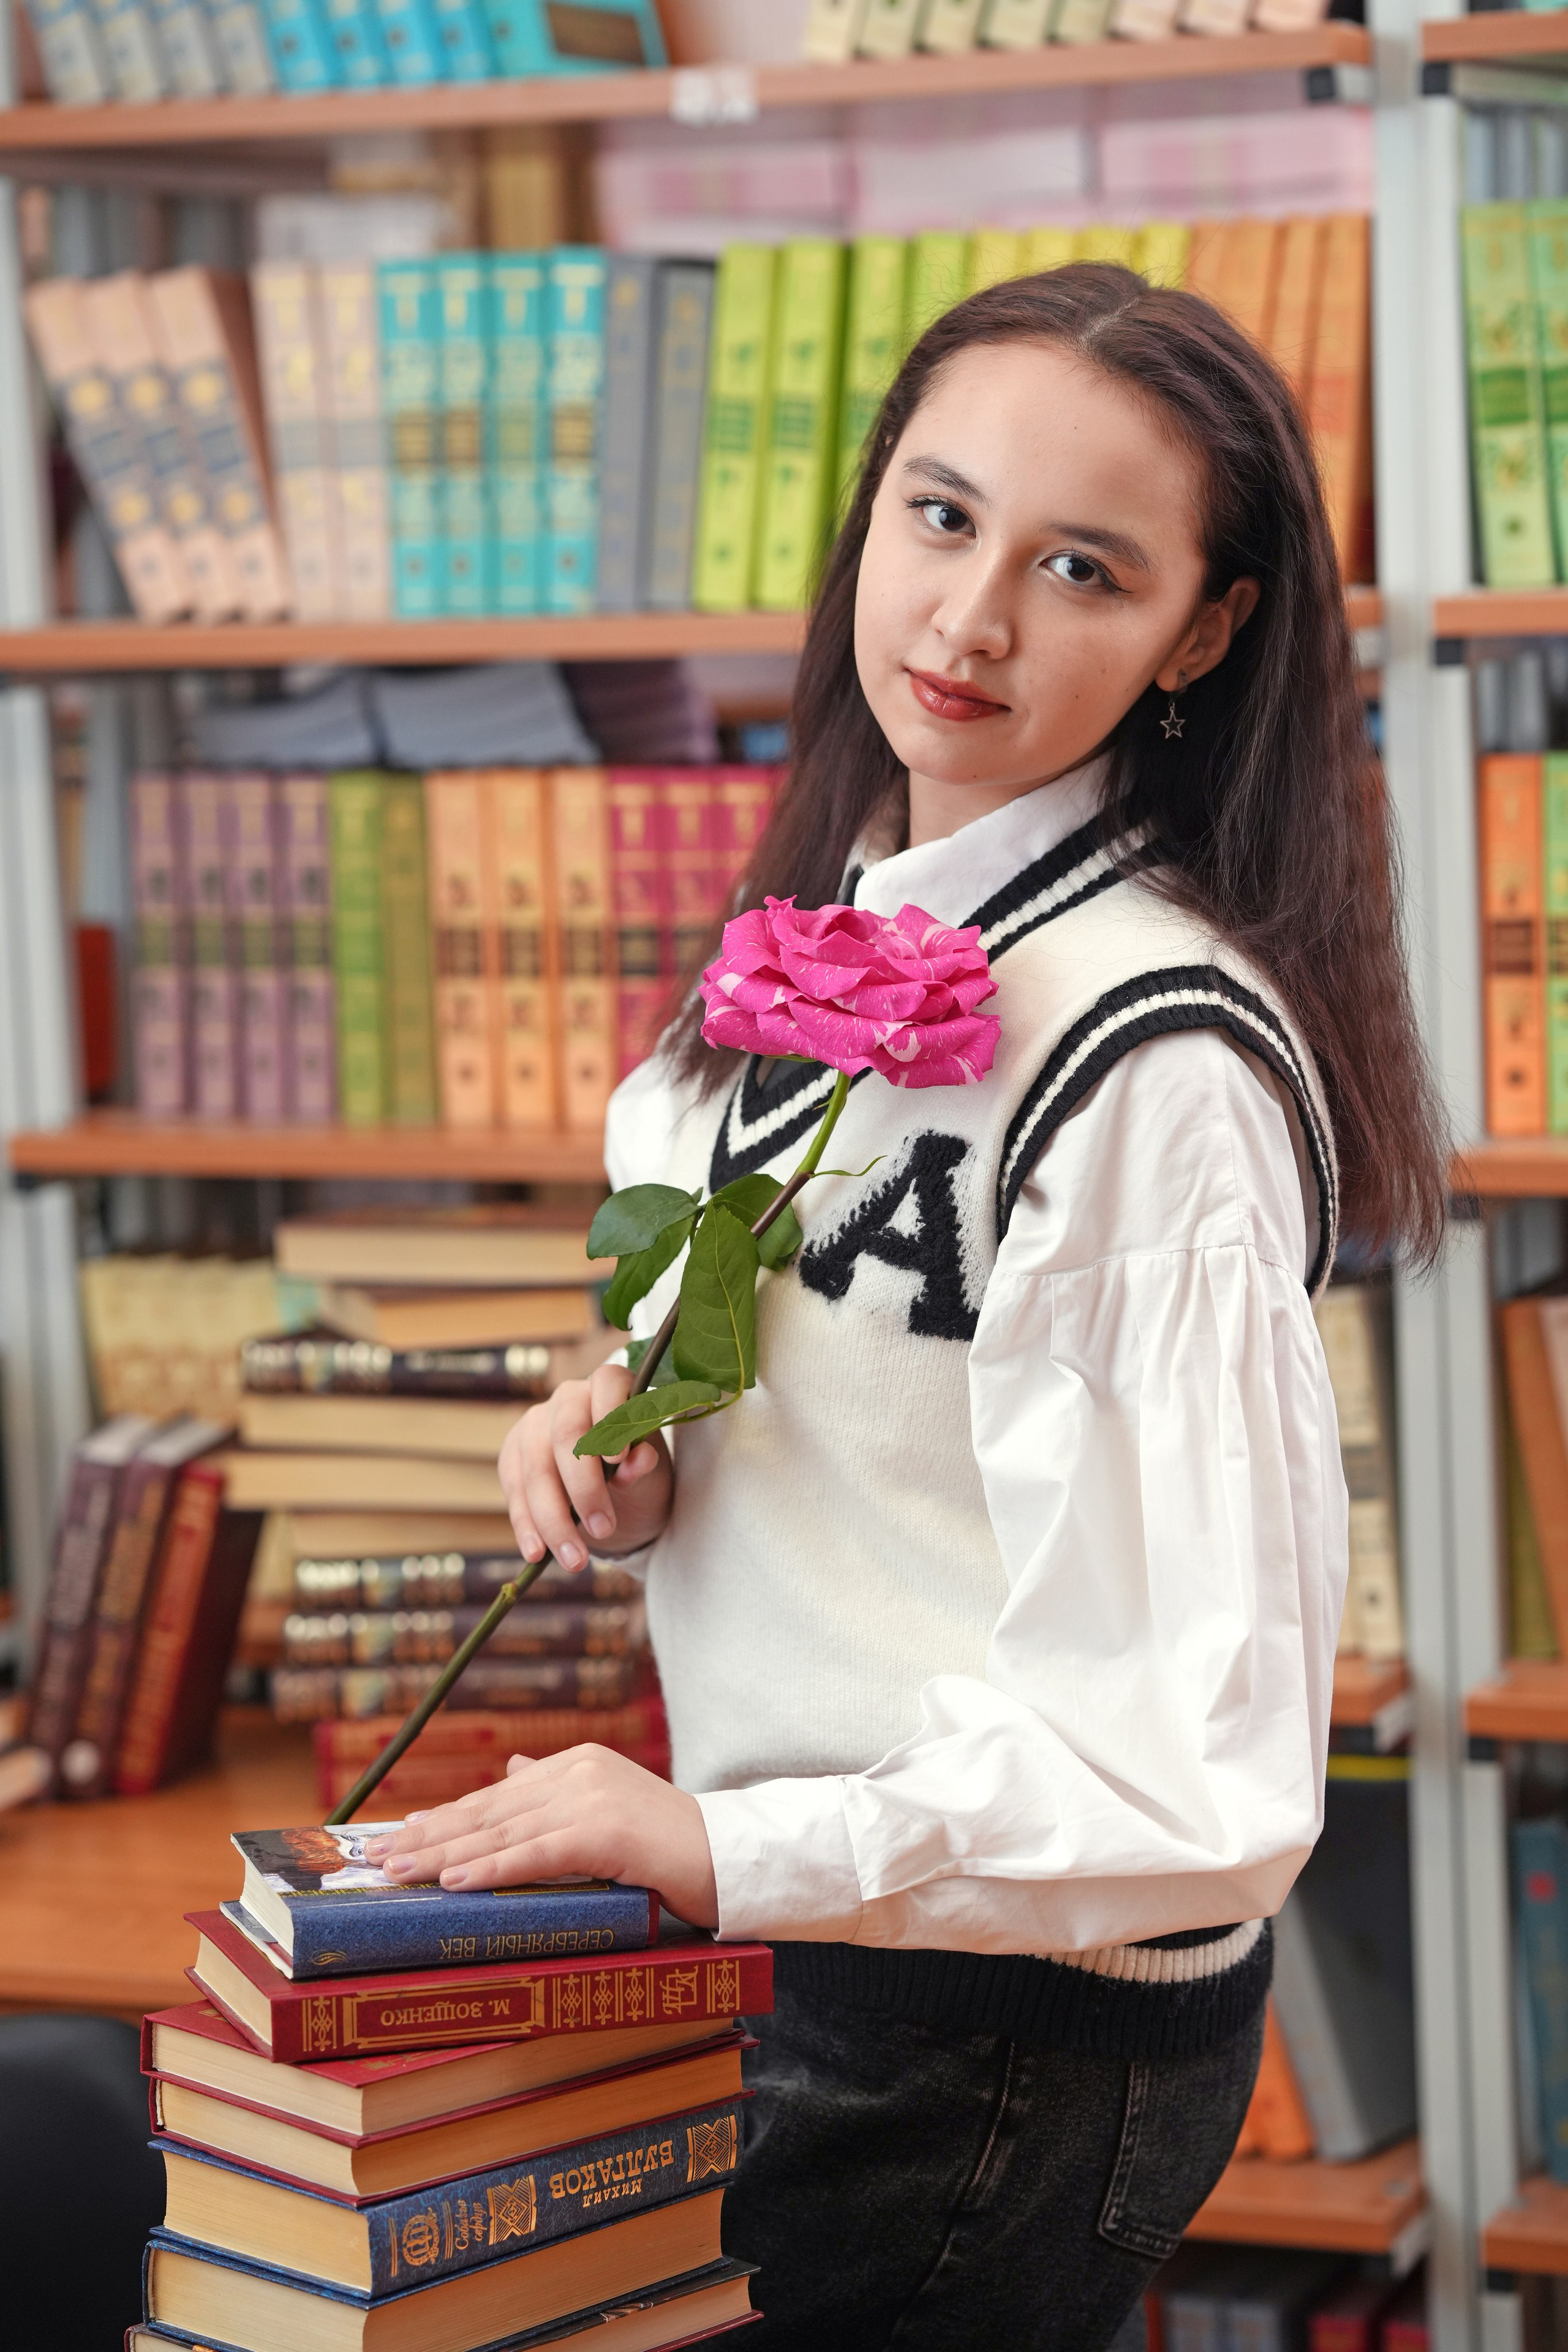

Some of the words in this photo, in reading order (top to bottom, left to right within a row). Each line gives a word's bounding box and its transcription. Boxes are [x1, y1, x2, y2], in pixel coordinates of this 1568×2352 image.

[799, 1130, 980, 1342] A
[440, 1937, 477, 1959] ВЕК
[486, 1929, 614, 1958] СЕРЕБРЯНЫЙ
[380, 2000, 483, 2026] ЗОЩЕНКО
[488, 1999, 510, 2015] М.
[549, 2140, 674, 2199] БУЛГАКОВ
